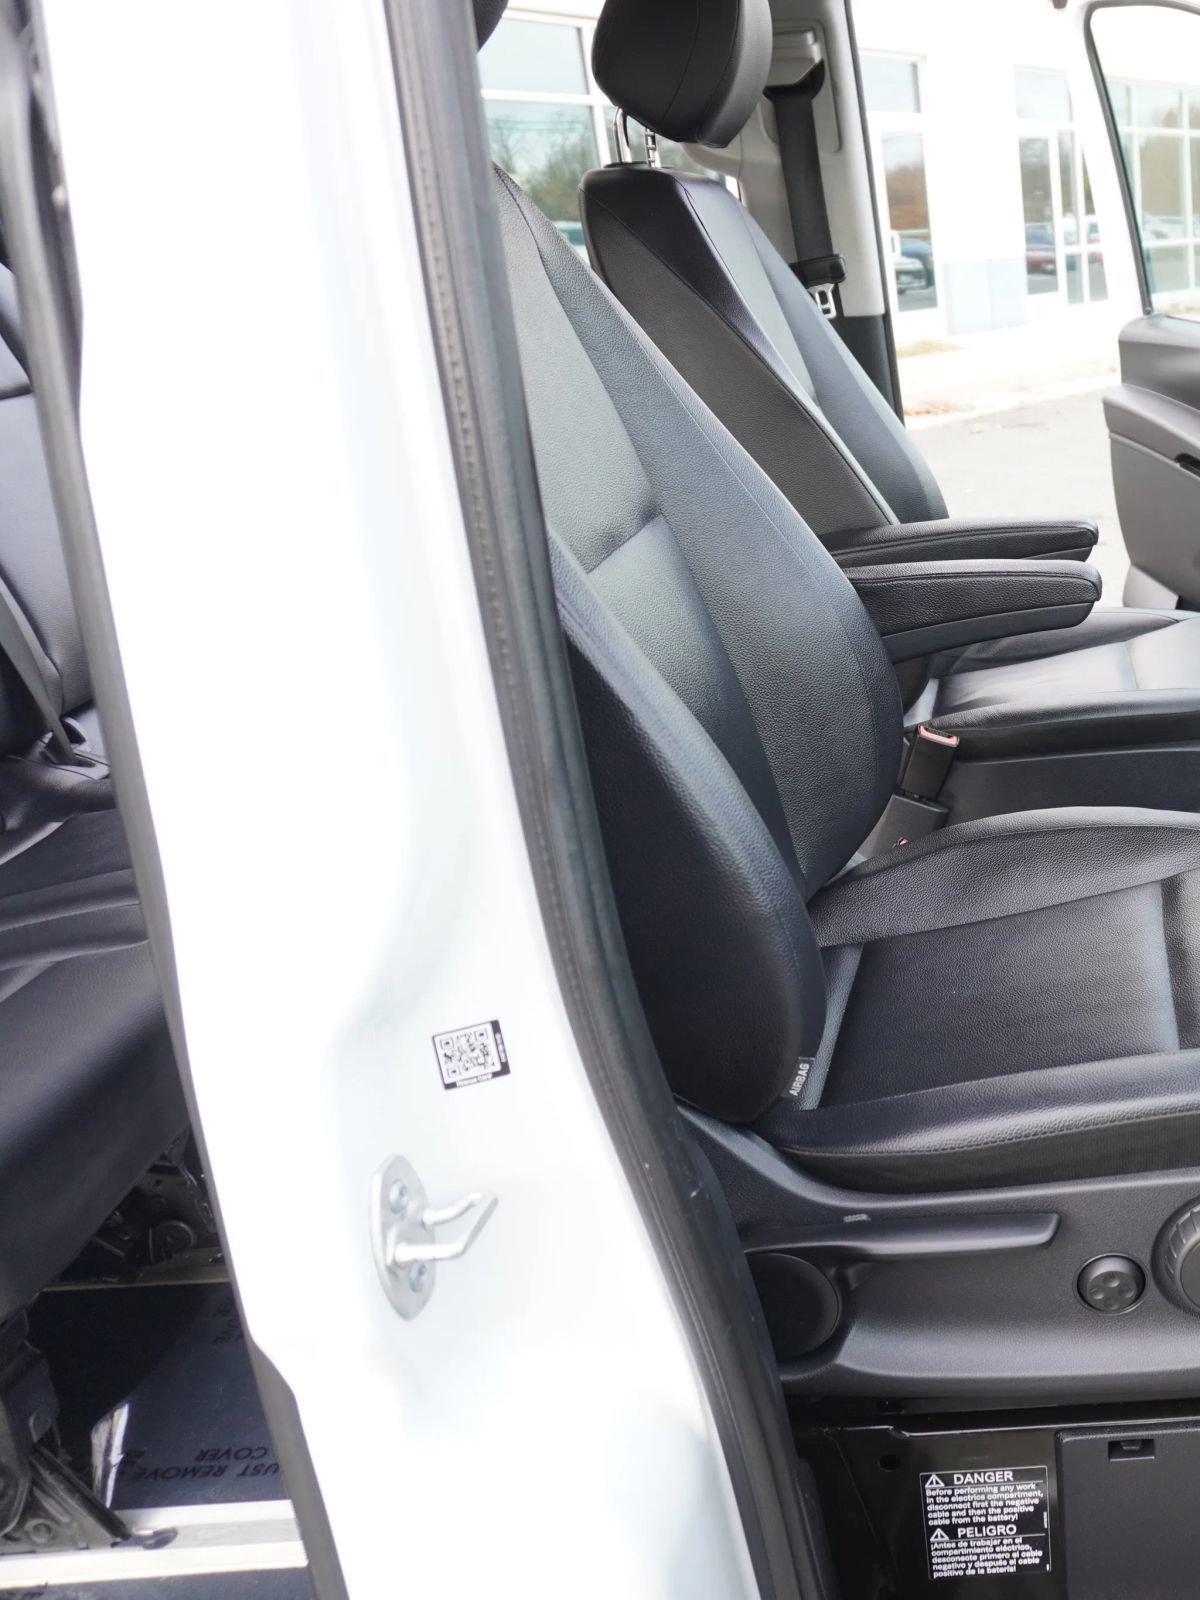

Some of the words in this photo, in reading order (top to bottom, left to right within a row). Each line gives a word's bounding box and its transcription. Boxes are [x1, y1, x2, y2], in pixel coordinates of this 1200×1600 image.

[789, 1063, 810, 1097] AIRBAG
[195, 1446, 269, 1462] COVER
[130, 1464, 229, 1482] REMOVE
[237, 1462, 281, 1478] UST
[953, 1471, 1014, 1485] DANGER
[926, 1488, 953, 1497] Before
[954, 1486, 999, 1496] performing
[1016, 1482, 1036, 1490] work
[987, 1490, 1044, 1500] compartment,
[927, 1503, 971, 1511] disconnect
[1005, 1498, 1040, 1507] negative
[927, 1511, 950, 1519] cable
[1003, 1505, 1035, 1514] positive
[928, 1518, 950, 1526] cable
[951, 1516, 971, 1524] from
[972, 1515, 986, 1523] the
[987, 1513, 1018, 1522] battery!
[957, 1524, 1017, 1538] PELIGRO
[957, 1540, 968, 1548] de
[970, 1538, 1001, 1547] trabajar
[1014, 1536, 1023, 1544] el
[931, 1547, 994, 1557] compartimiento
[932, 1555, 978, 1564] desconecte
[979, 1553, 1010, 1561] primero
[1021, 1549, 1043, 1557] cable
[932, 1562, 966, 1571] negativo
[967, 1562, 973, 1570] y
[974, 1559, 1008, 1568] después
[1018, 1557, 1040, 1565] cable
[933, 1570, 964, 1579] positivo
